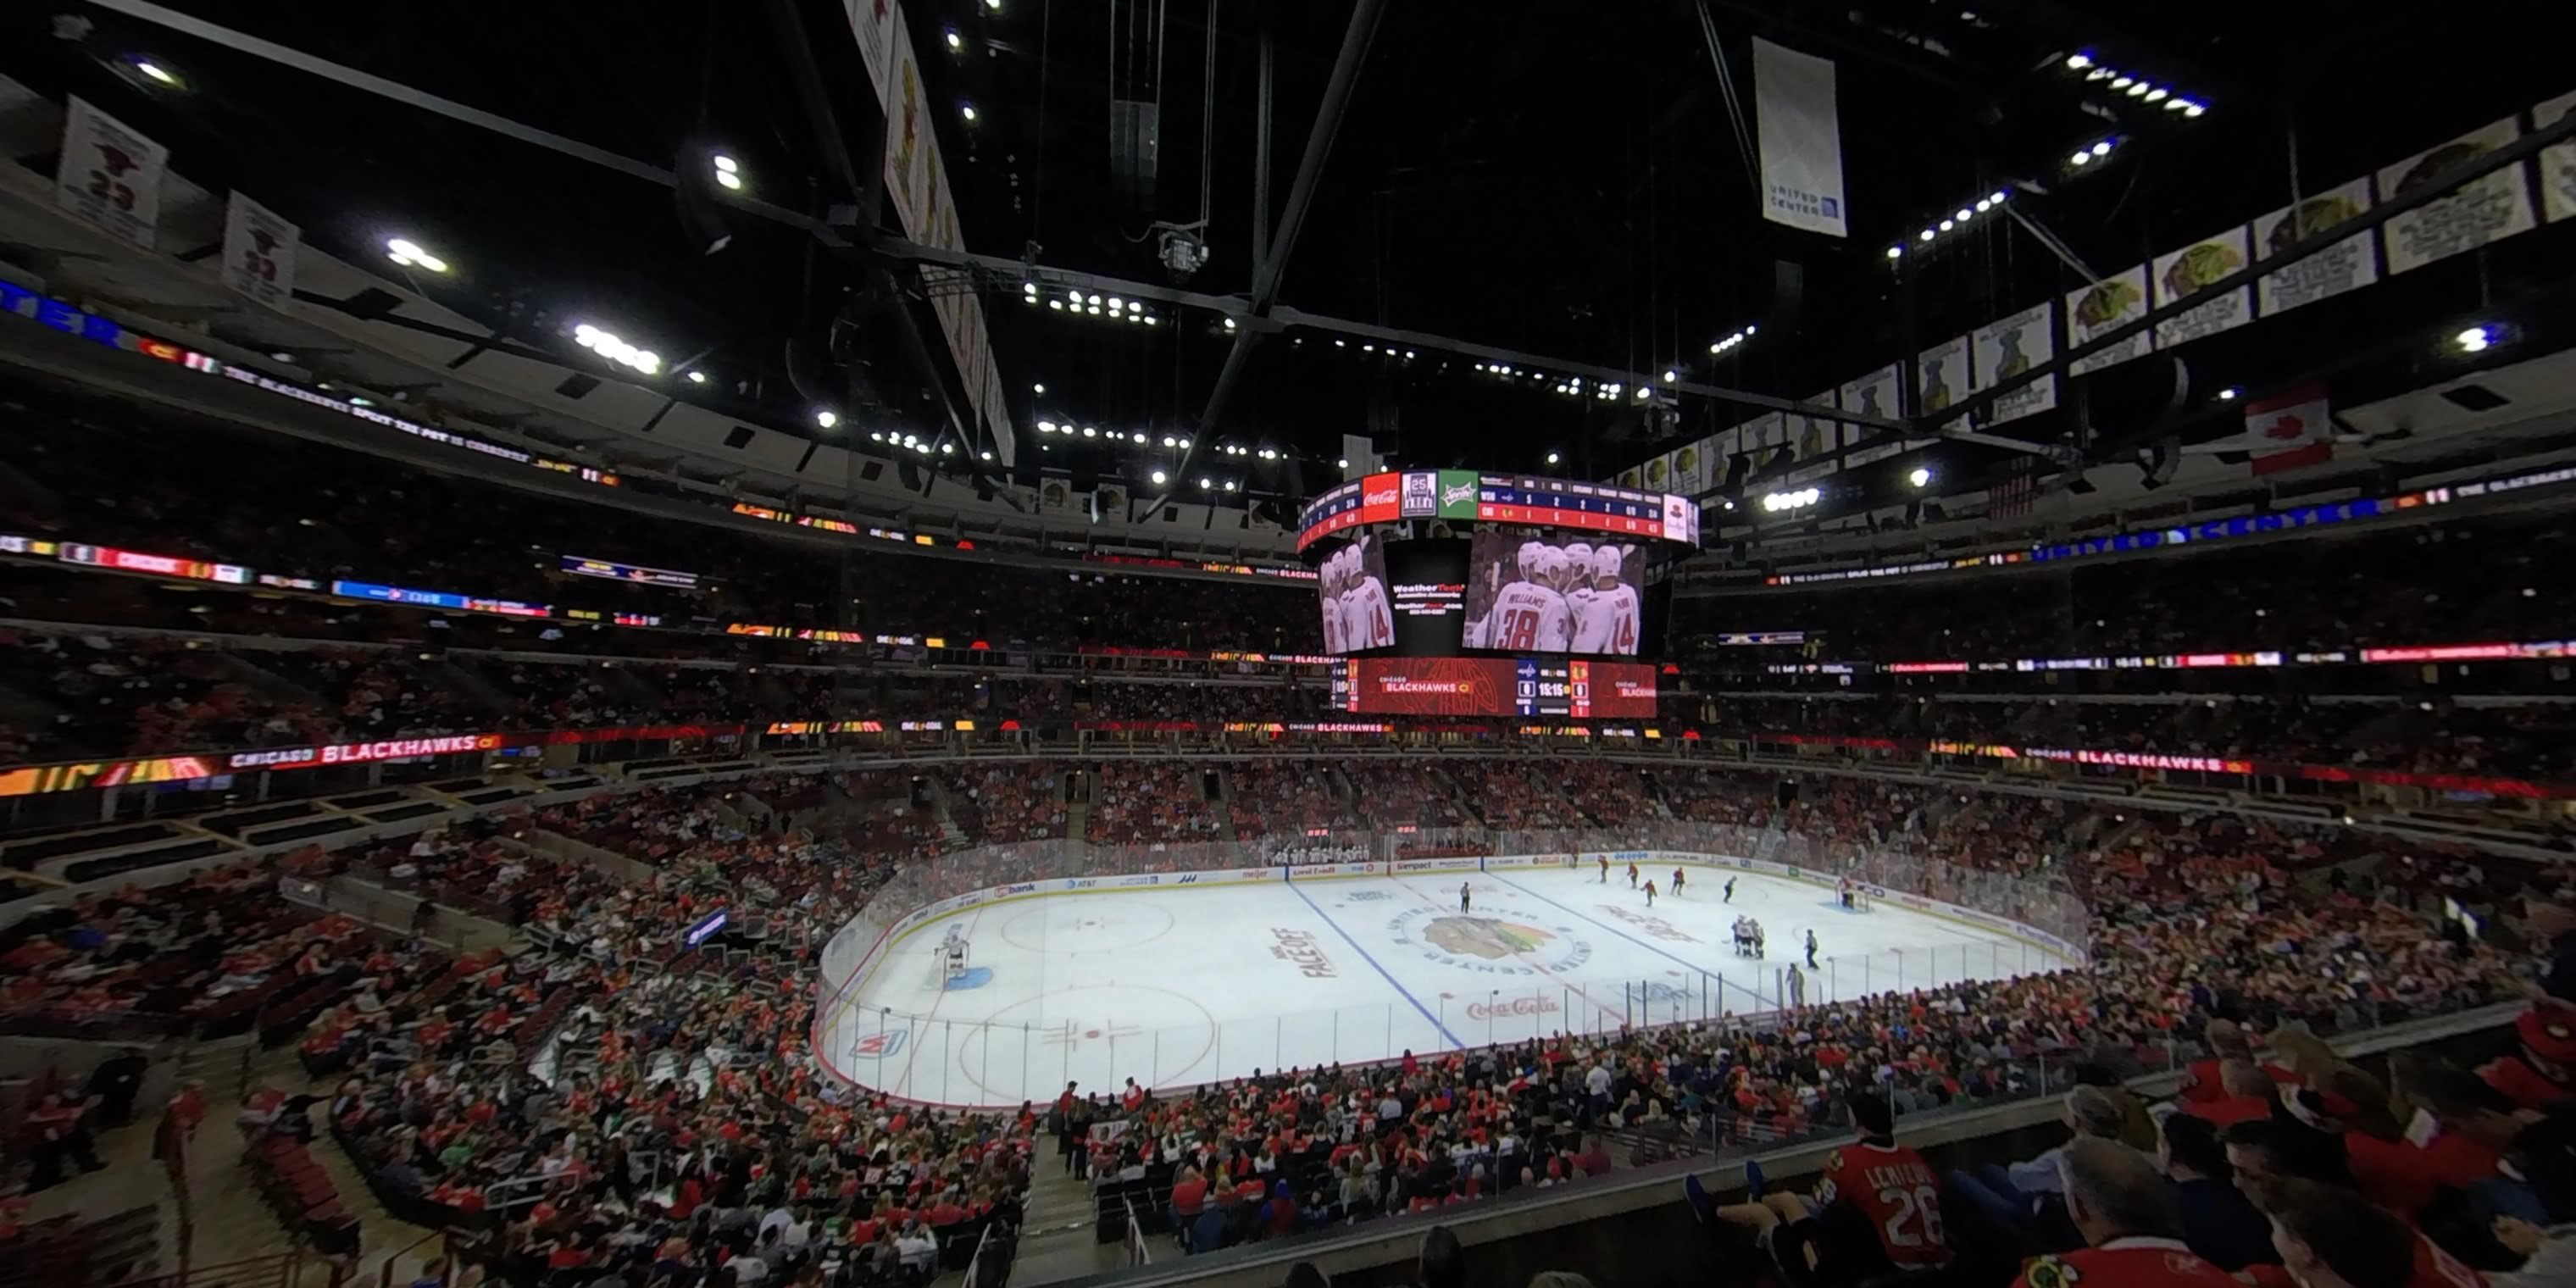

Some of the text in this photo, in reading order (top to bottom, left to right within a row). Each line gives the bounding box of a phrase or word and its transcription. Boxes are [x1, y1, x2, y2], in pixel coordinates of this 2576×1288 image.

[1770, 183, 1819, 204] UNITED
[1771, 196, 1820, 216] CENTER
[1412, 477, 1427, 491] 25
[1363, 489, 1398, 508] Coca-Cola
[1394, 583, 1465, 593] WeatherTech
[1508, 593, 1546, 609] WILLIAMS
[1497, 609, 1540, 651] 38
[1387, 683, 1457, 693] BLACKHAWKS
[1539, 683, 1563, 696] 15:15
[1317, 723, 1383, 734] BLACKHAWKS
[230, 735, 477, 768] CHICAGO BLACKHAWKS
[2078, 750, 2223, 773] BLACKHAWKS
[1077, 880, 1097, 888] AT&T
[1243, 869, 1268, 882] meijer
[1466, 995, 1560, 1021] Coca-Cola
[1879, 1184, 1947, 1246] 26
